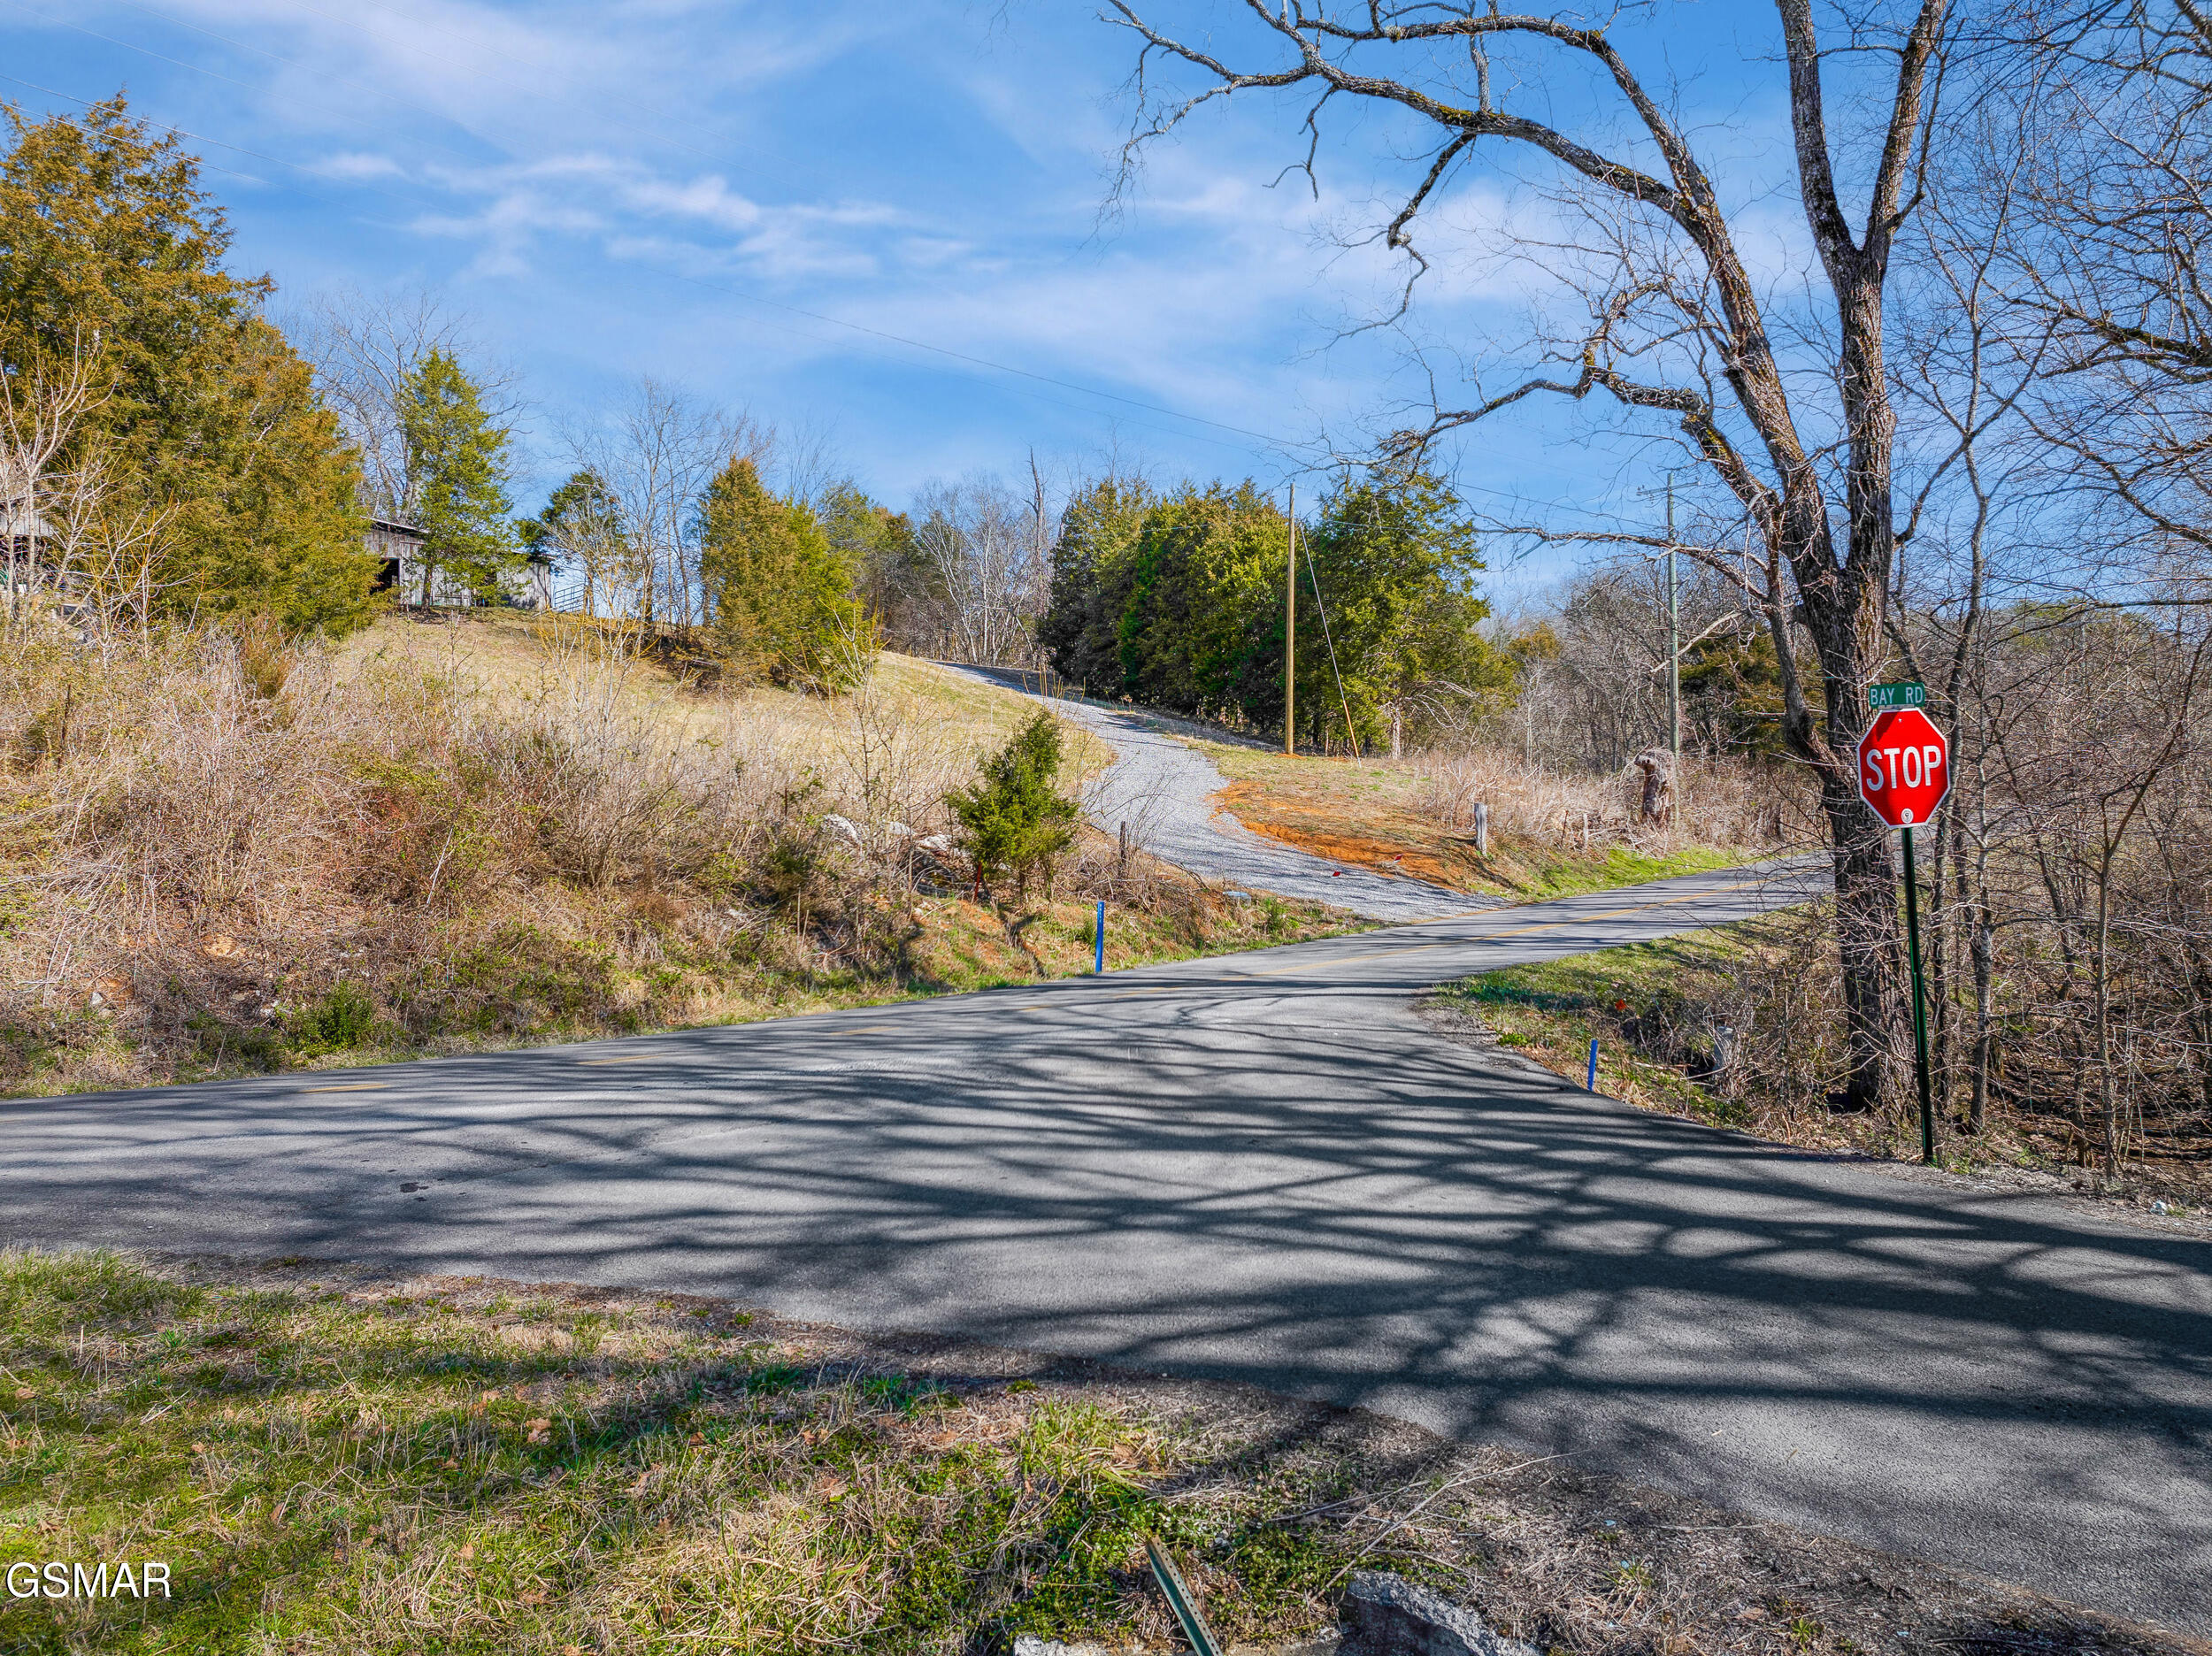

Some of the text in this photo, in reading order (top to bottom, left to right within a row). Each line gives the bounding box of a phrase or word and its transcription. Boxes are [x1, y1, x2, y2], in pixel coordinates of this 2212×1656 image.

[1870, 686, 1924, 705] BAY RD
[1866, 745, 1941, 791] STOP
